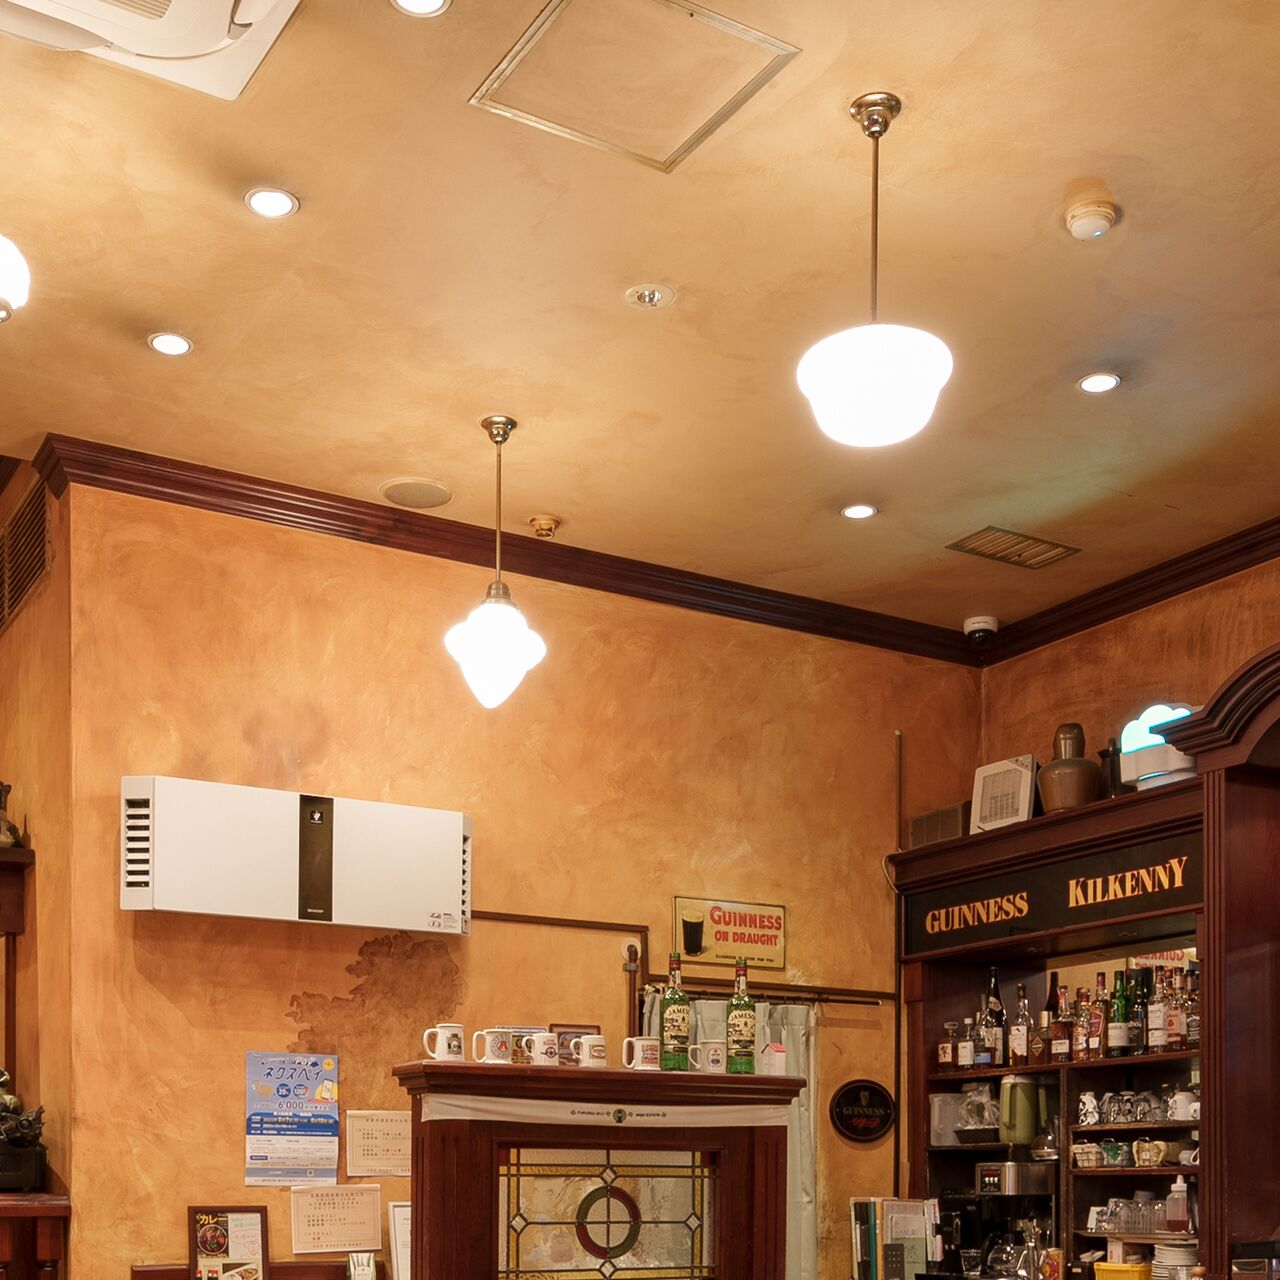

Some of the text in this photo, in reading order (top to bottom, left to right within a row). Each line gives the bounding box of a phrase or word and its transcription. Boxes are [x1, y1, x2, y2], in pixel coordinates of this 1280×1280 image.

[925, 856, 1189, 935] GUINNESS KILKENNY
[709, 905, 782, 931] GUINNESS
[715, 930, 778, 946] ON DRAUGHT
[668, 1006, 689, 1015] JAMES
[731, 1012, 755, 1020] JAMESO
[263, 1066, 323, 1081] ネクスペイ
[199, 1214, 228, 1224] カレー
